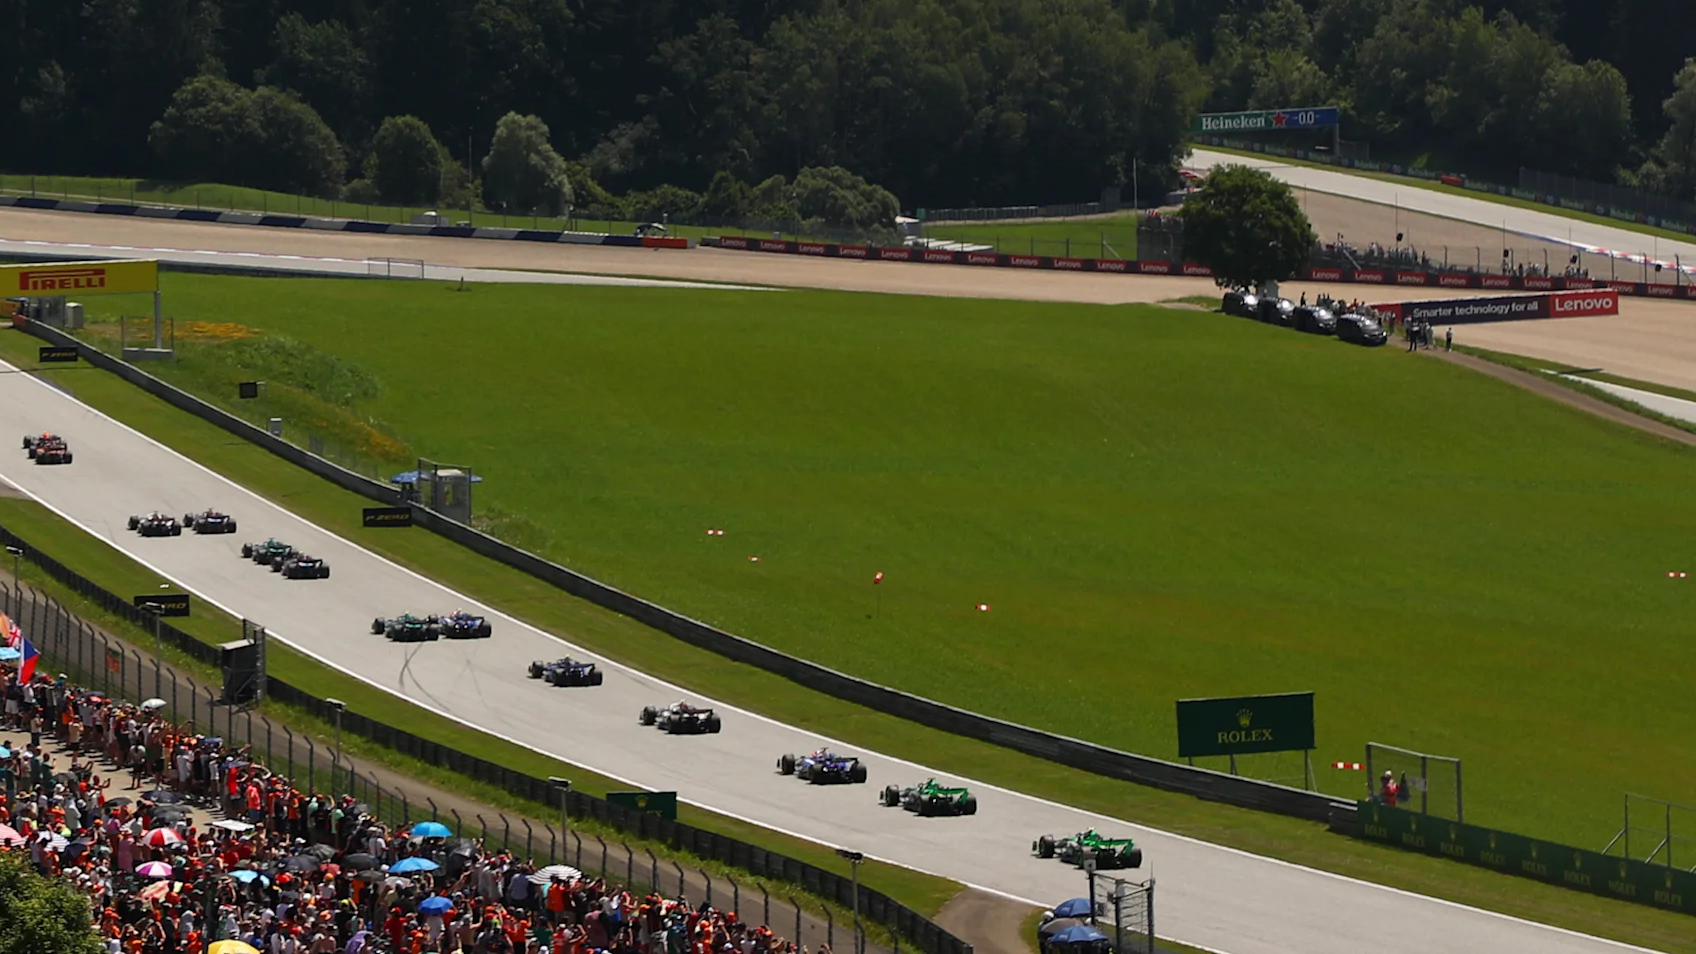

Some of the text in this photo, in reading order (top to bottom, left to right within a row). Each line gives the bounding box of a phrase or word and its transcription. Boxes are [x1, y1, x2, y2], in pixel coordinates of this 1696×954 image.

[1202, 115, 1265, 131] Heineken
[924, 252, 952, 262] Lenovo
[968, 254, 995, 264] Lenovo
[1011, 257, 1039, 266] Lenovo
[1054, 259, 1082, 269] Lenovo
[1097, 261, 1125, 271] Lenovo
[1140, 263, 1168, 273] Lenovo
[1183, 265, 1211, 275] Lenovo
[19, 268, 106, 291] PIRELLI
[1312, 271, 1340, 280] Lenovo
[1355, 273, 1383, 282] Lenovo
[1397, 274, 1425, 284] Lenovo
[1439, 276, 1467, 286] Lenovo
[1482, 277, 1510, 287] Lenovo
[1524, 278, 1552, 288] Lenovo
[1648, 285, 1674, 295] Lenovo
[1413, 300, 1539, 318] Smarter technology for all
[1555, 297, 1613, 312] Lenovo
[1217, 729, 1274, 744] ROLEX
